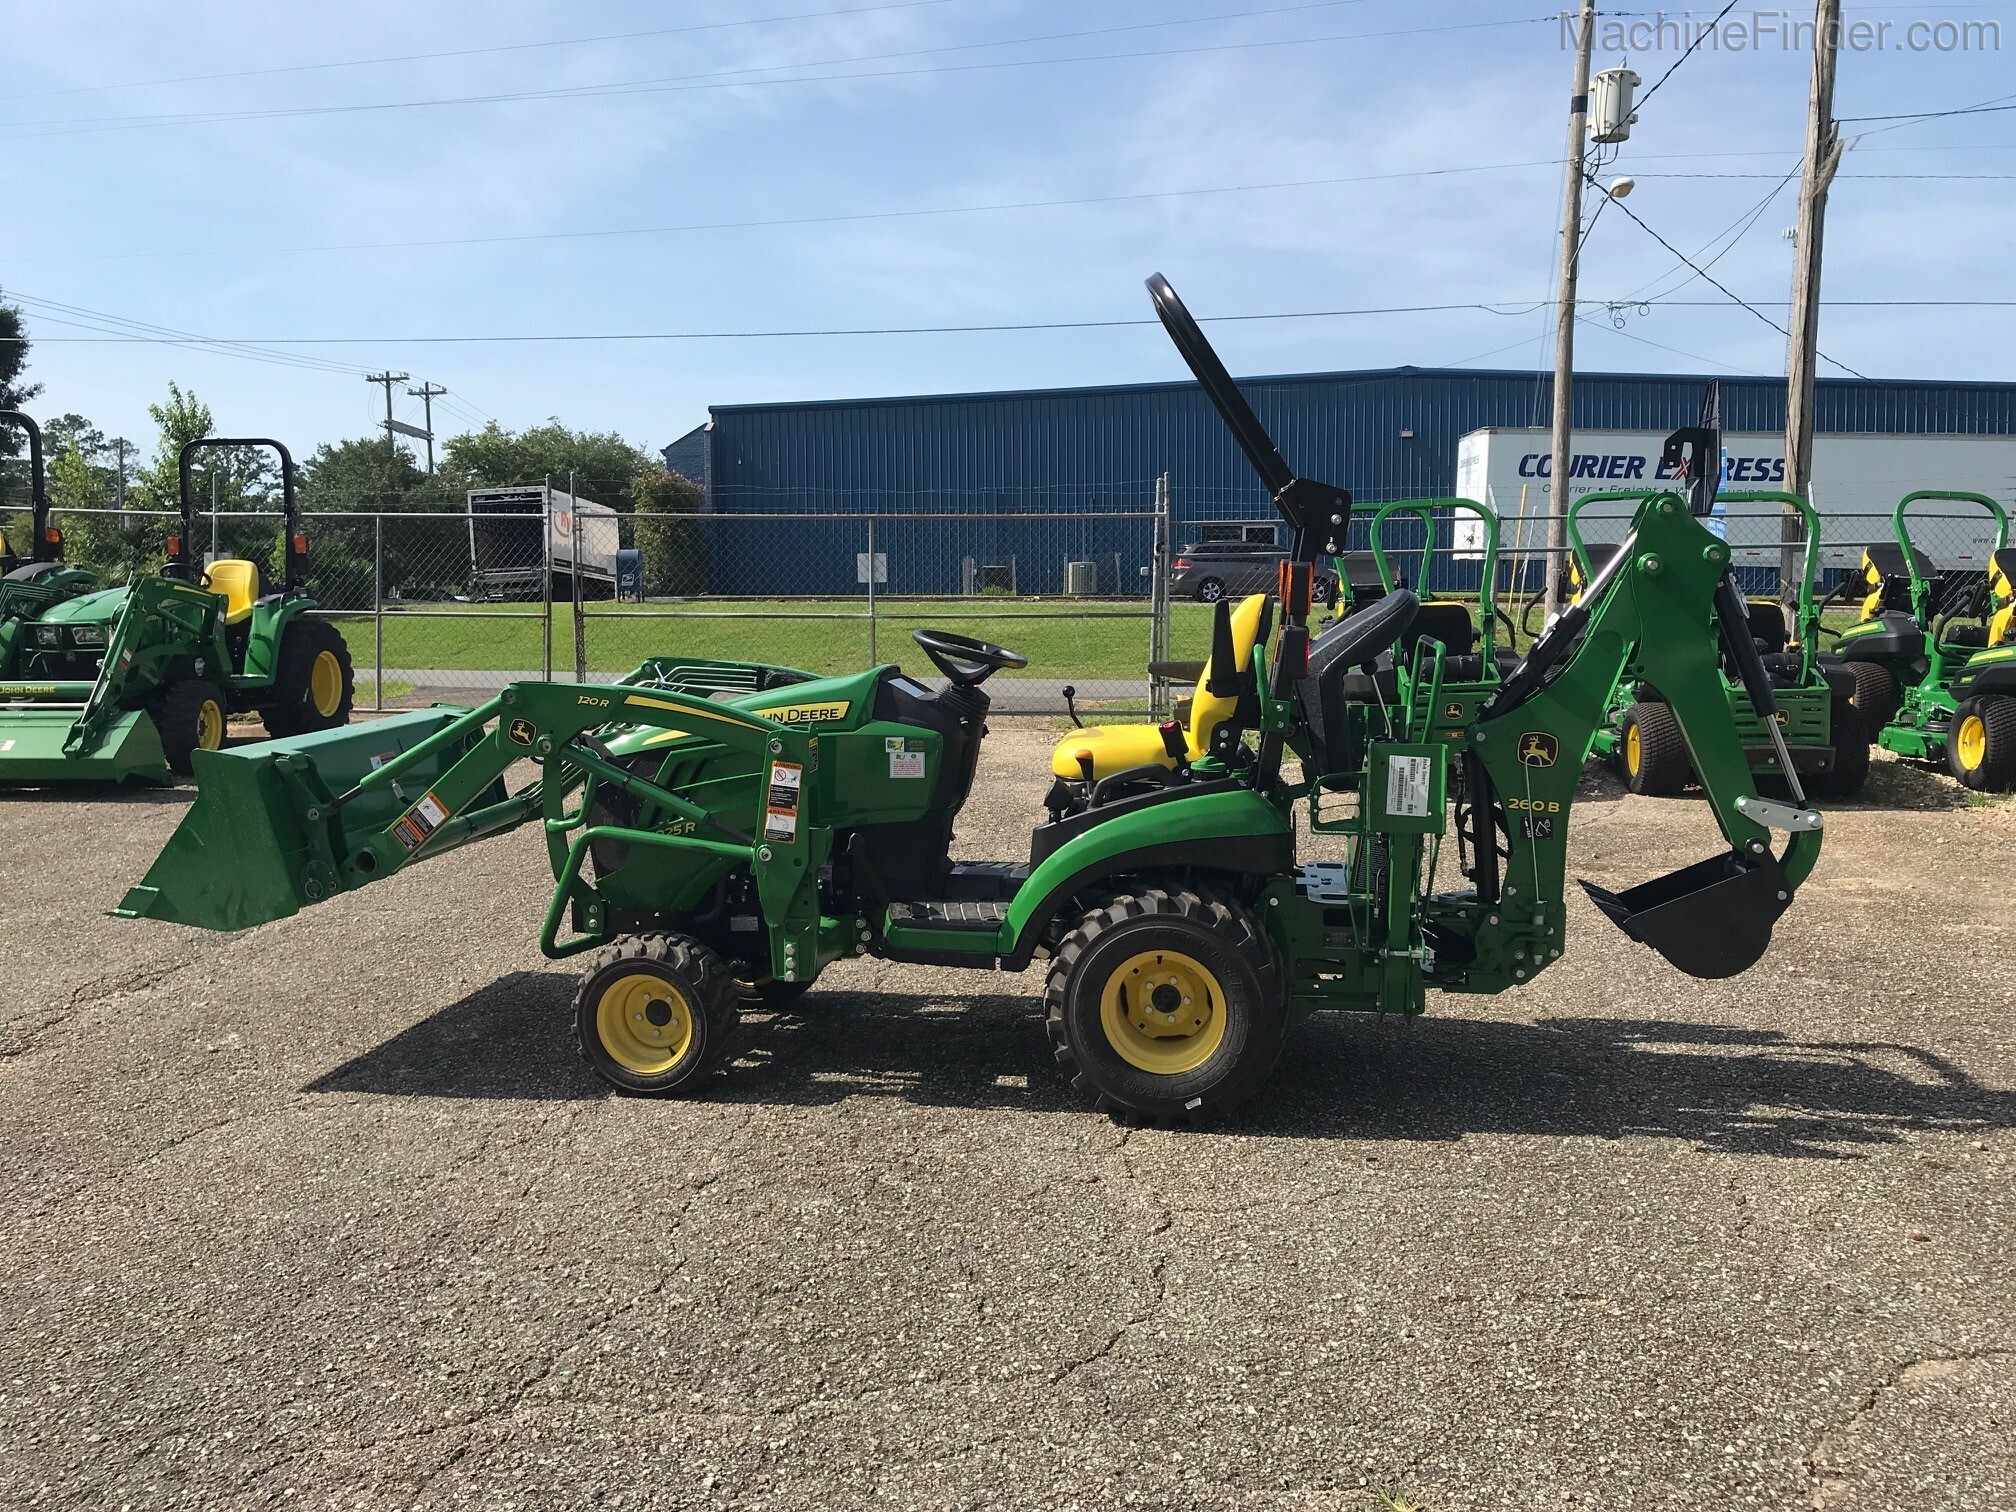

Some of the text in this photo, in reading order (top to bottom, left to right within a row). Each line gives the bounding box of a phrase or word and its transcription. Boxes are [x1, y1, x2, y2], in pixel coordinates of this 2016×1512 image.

[0, 686, 56, 694] JOHN DEERE
[577, 695, 610, 708] 120 R
[762, 708, 839, 723] HN DEERE
[1508, 798, 1560, 813] 260 B
[685, 821, 696, 834] R
